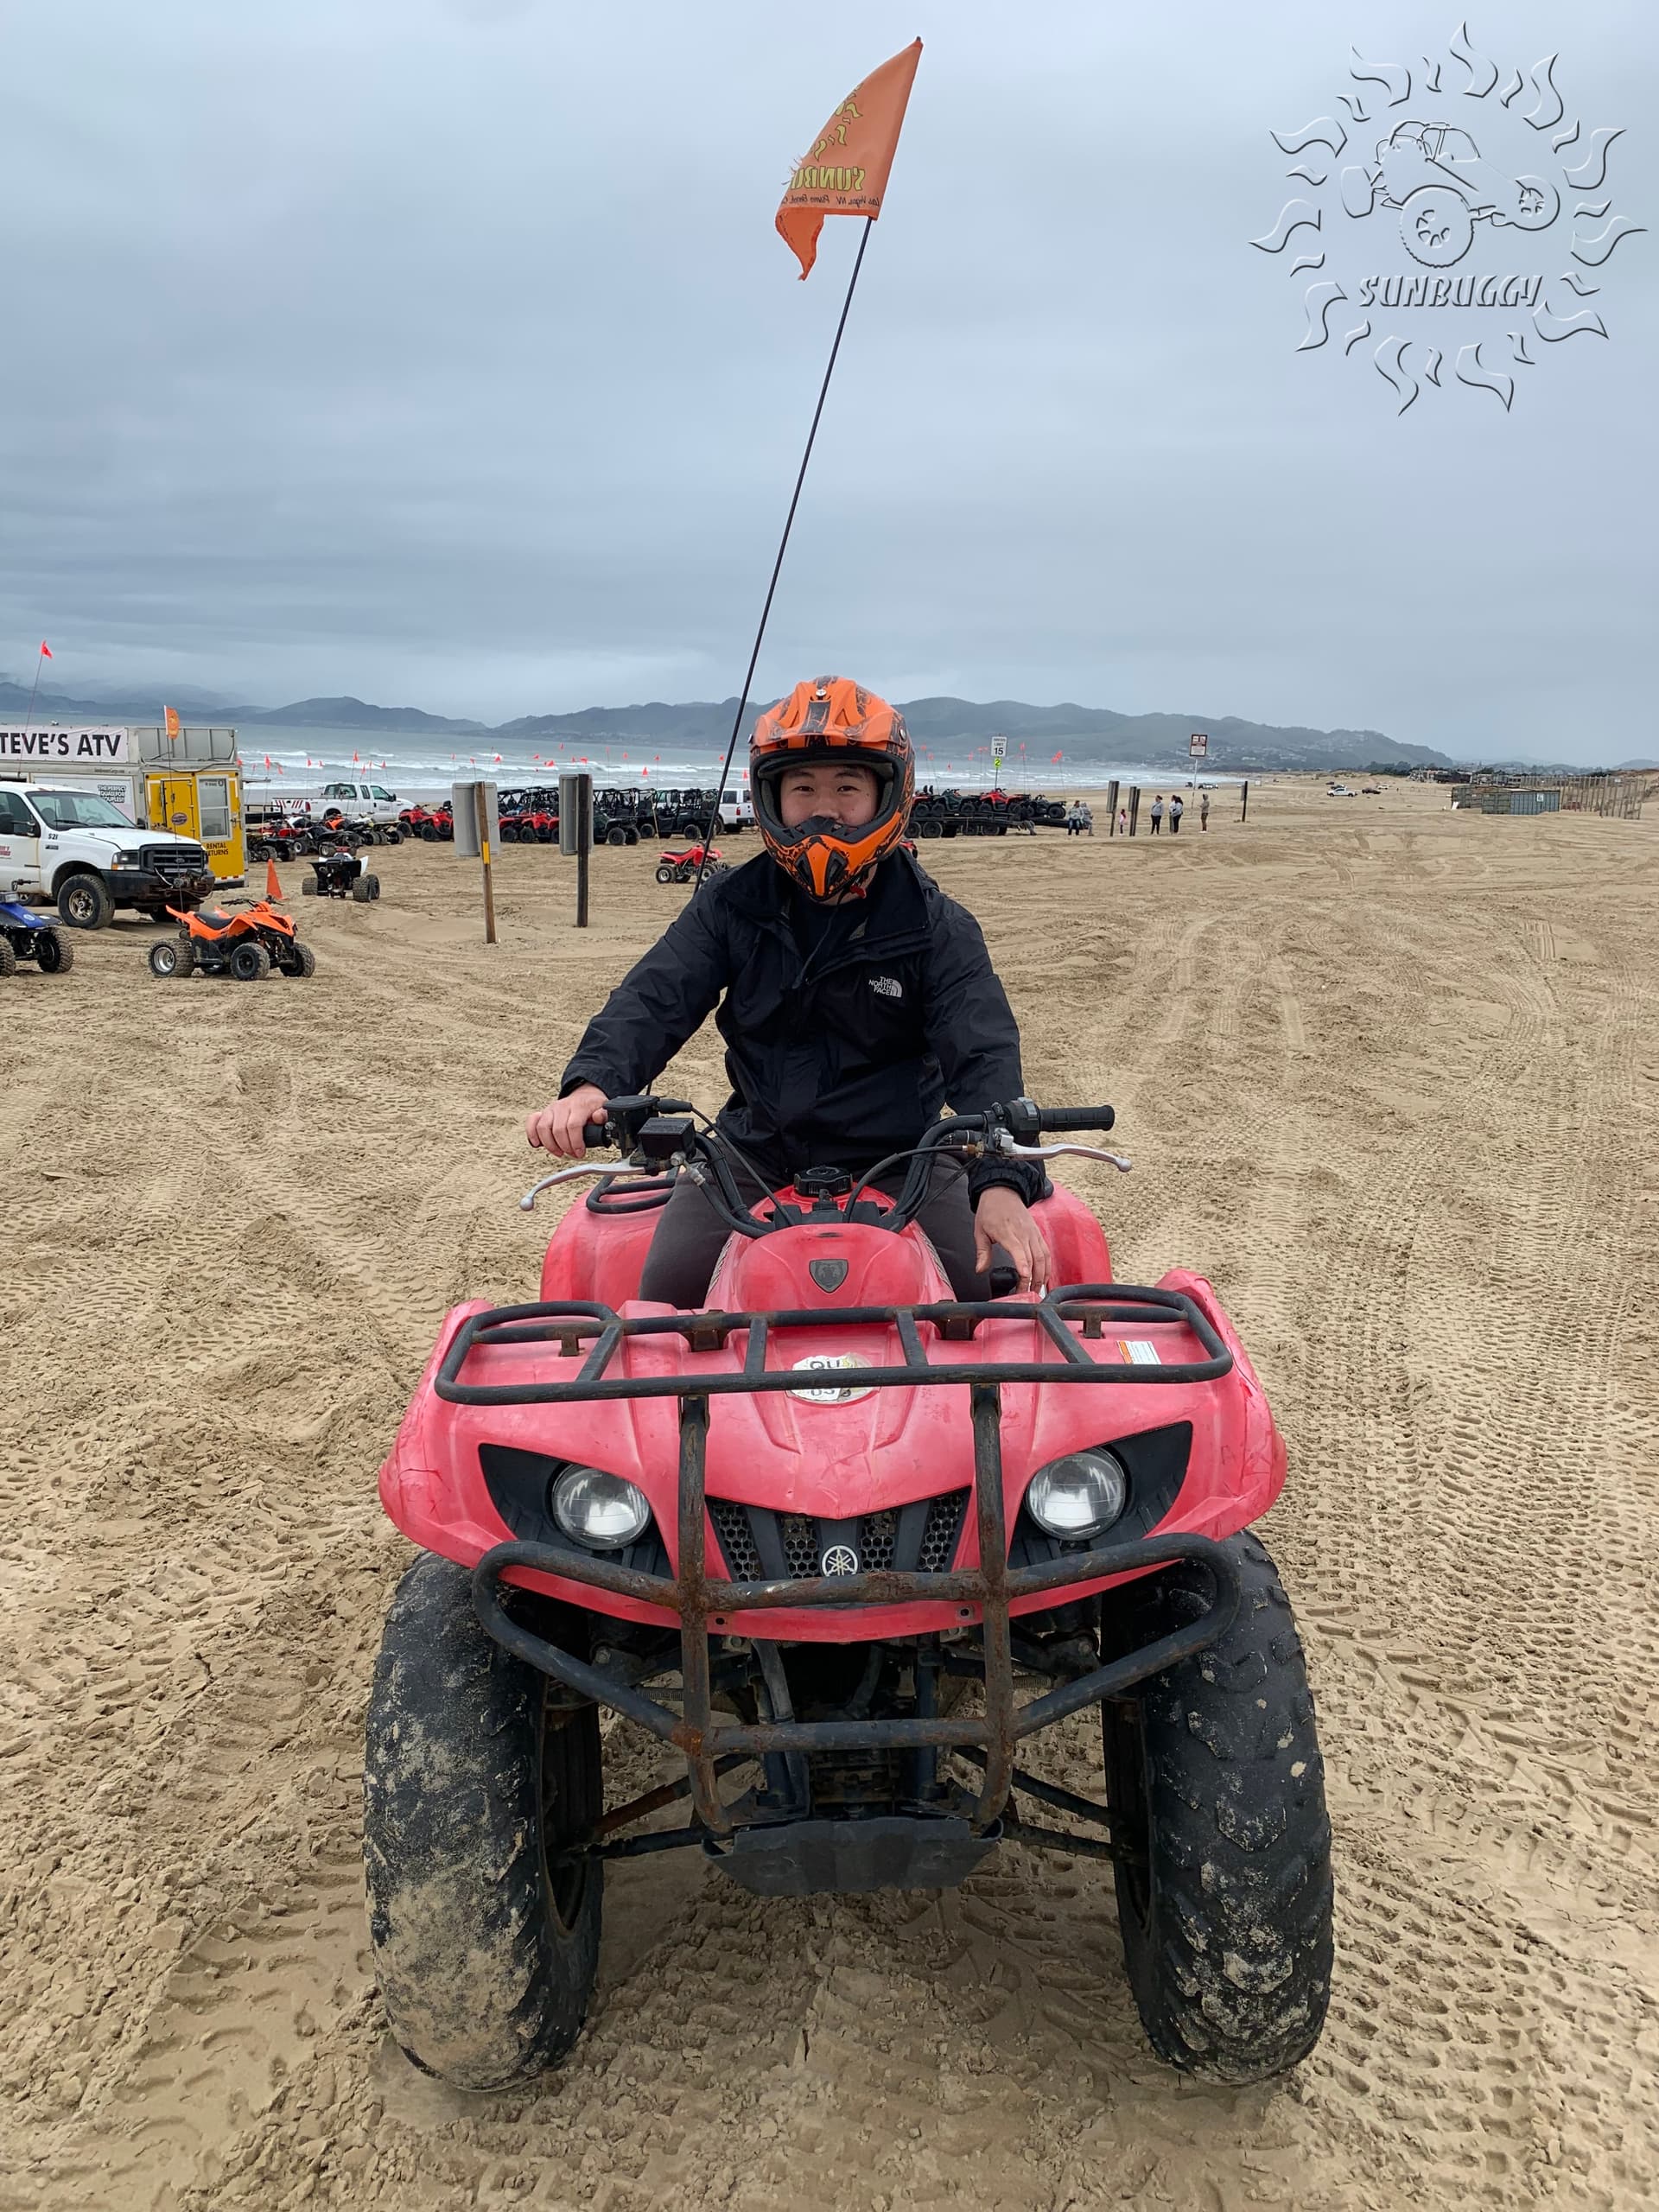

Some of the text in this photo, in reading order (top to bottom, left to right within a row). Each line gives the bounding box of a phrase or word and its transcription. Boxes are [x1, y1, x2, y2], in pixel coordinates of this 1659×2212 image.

[77, 734, 121, 756] ATV
[868, 979, 893, 990] NORTH
[880, 976, 893, 985] THE
[874, 985, 891, 995] FACE
